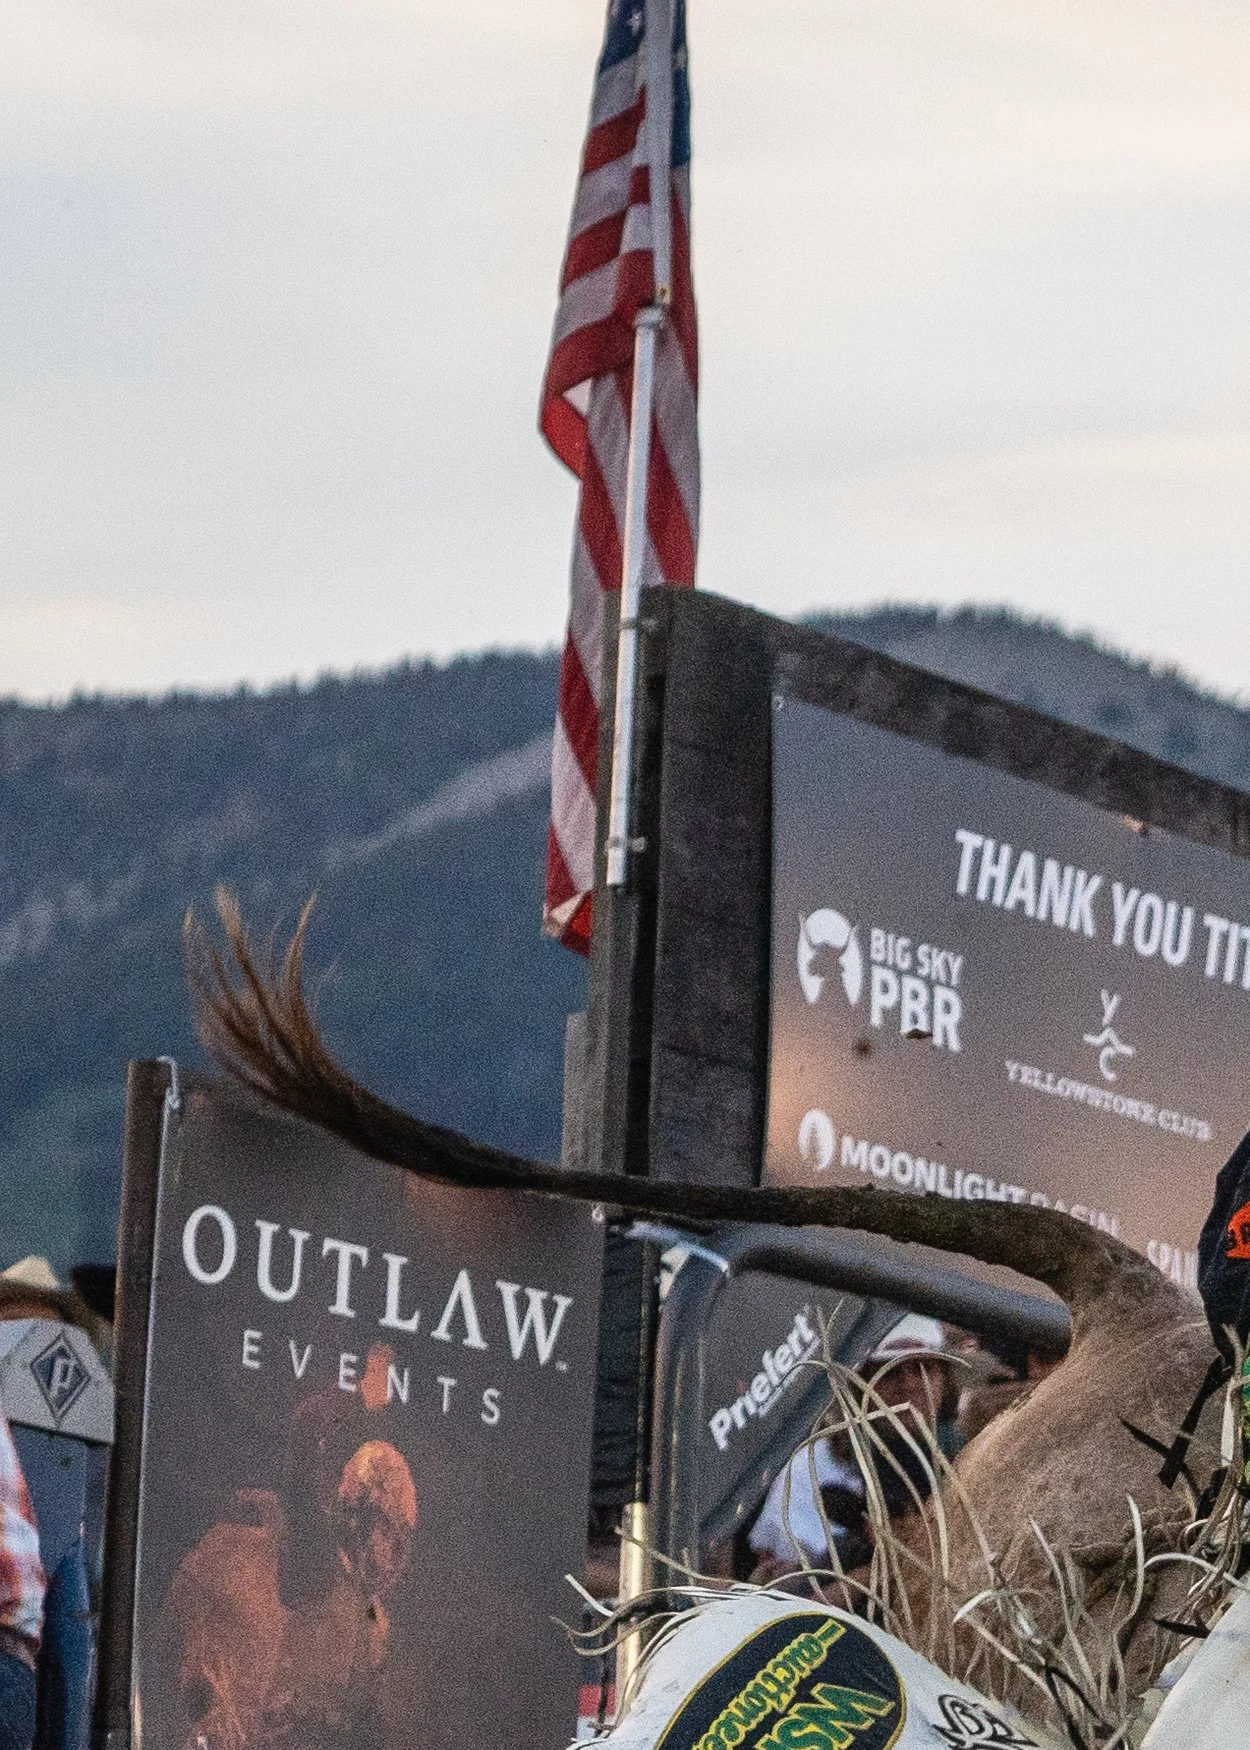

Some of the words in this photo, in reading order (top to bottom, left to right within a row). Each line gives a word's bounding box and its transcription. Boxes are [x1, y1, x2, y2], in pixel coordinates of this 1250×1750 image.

[954, 828, 1101, 939] THANK
[1111, 881, 1195, 968] YOU
[869, 926, 912, 968] BIG
[914, 942, 964, 991] SKY
[869, 967, 962, 1052] PBR
[1004, 1058, 1158, 1127] YELLOWSTONE
[1157, 1108, 1213, 1143] CLUB
[840, 1135, 1026, 1205] MOONLIGHT
[182, 1204, 573, 1367] OUTLAW
[241, 1328, 502, 1427] EVENTS
[708, 1312, 821, 1451] Priefert
